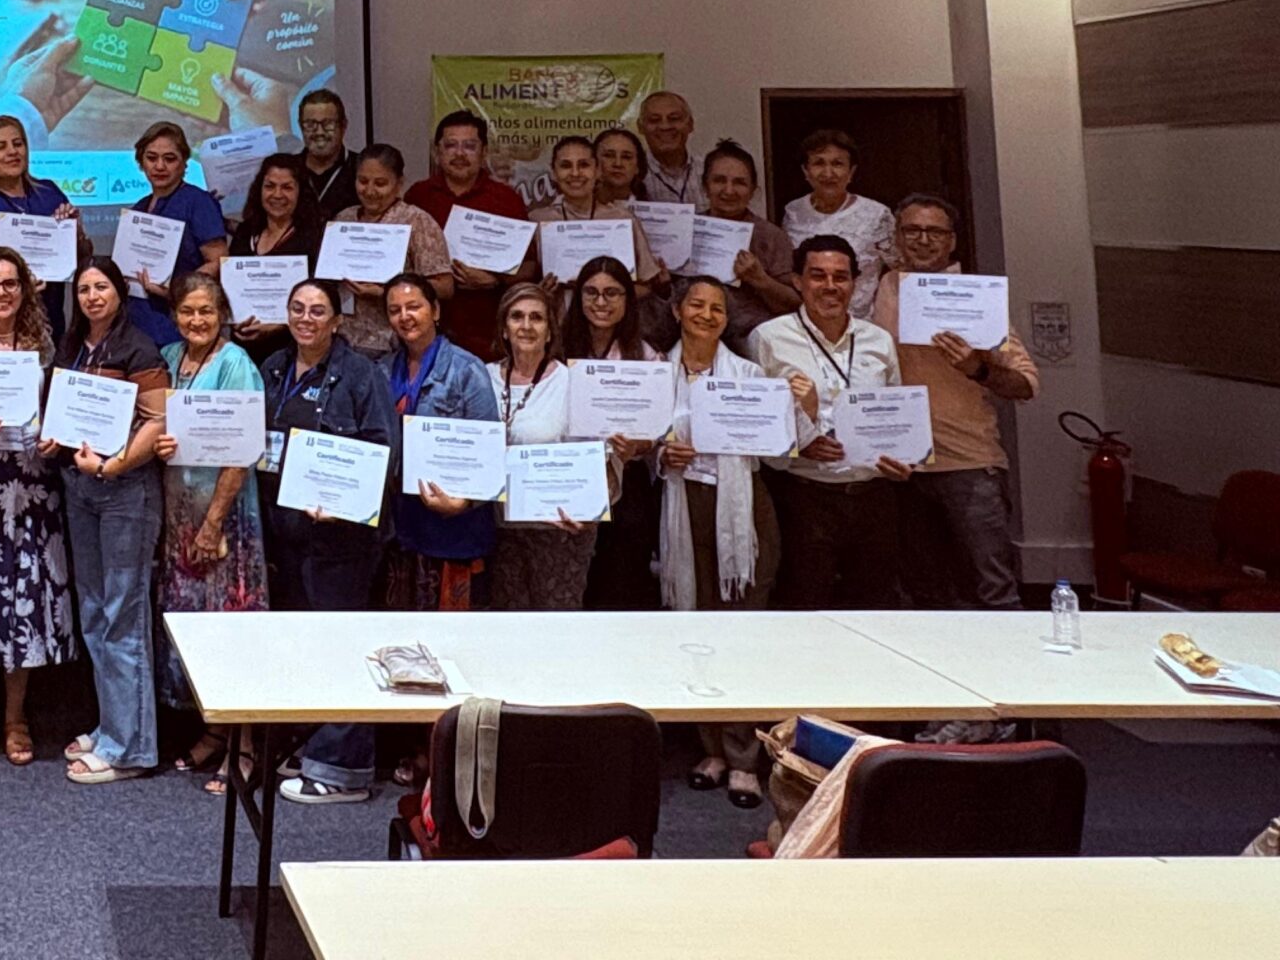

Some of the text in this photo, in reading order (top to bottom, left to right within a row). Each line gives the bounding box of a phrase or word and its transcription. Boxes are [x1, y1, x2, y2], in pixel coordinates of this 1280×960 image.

[168, 82, 199, 97] MAYOR
[163, 91, 200, 107] IMPACTO
[524, 116, 625, 129] alimentamos
[497, 131, 527, 144] más
[532, 134, 540, 146] y
